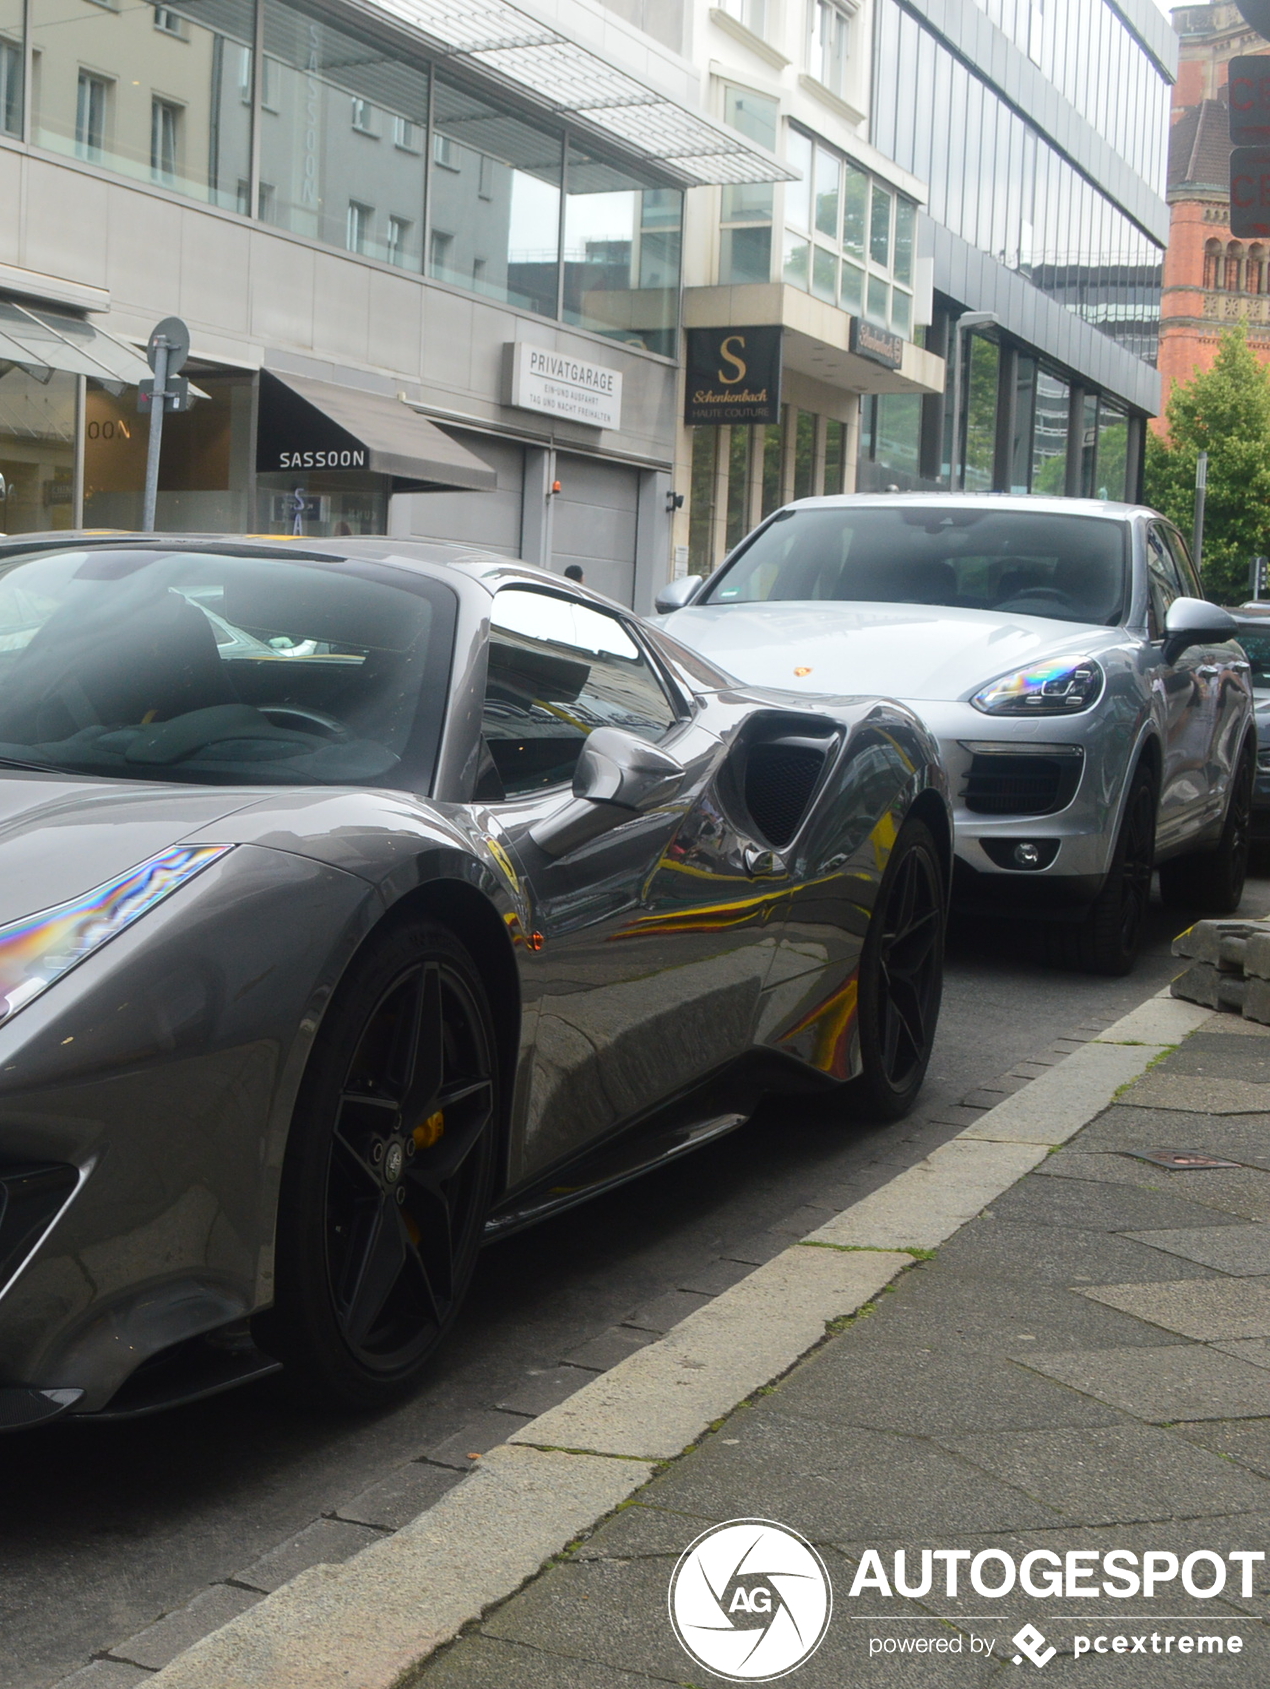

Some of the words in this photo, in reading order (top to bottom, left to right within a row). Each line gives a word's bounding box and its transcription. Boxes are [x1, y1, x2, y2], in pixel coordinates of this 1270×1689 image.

[717, 335, 747, 385] S
[530, 352, 614, 391] PRIVATGARAGE
[570, 391, 599, 406] AUSFAHRT
[692, 388, 768, 404] Schenkenbach
[529, 393, 542, 405] TAG
[542, 397, 556, 409] UND
[557, 400, 577, 414] NACHT
[577, 405, 611, 422] FREIHALTEN
[692, 408, 723, 418] HAUTE
[724, 406, 770, 417] COUTURE
[279, 451, 364, 468] SASSOON
